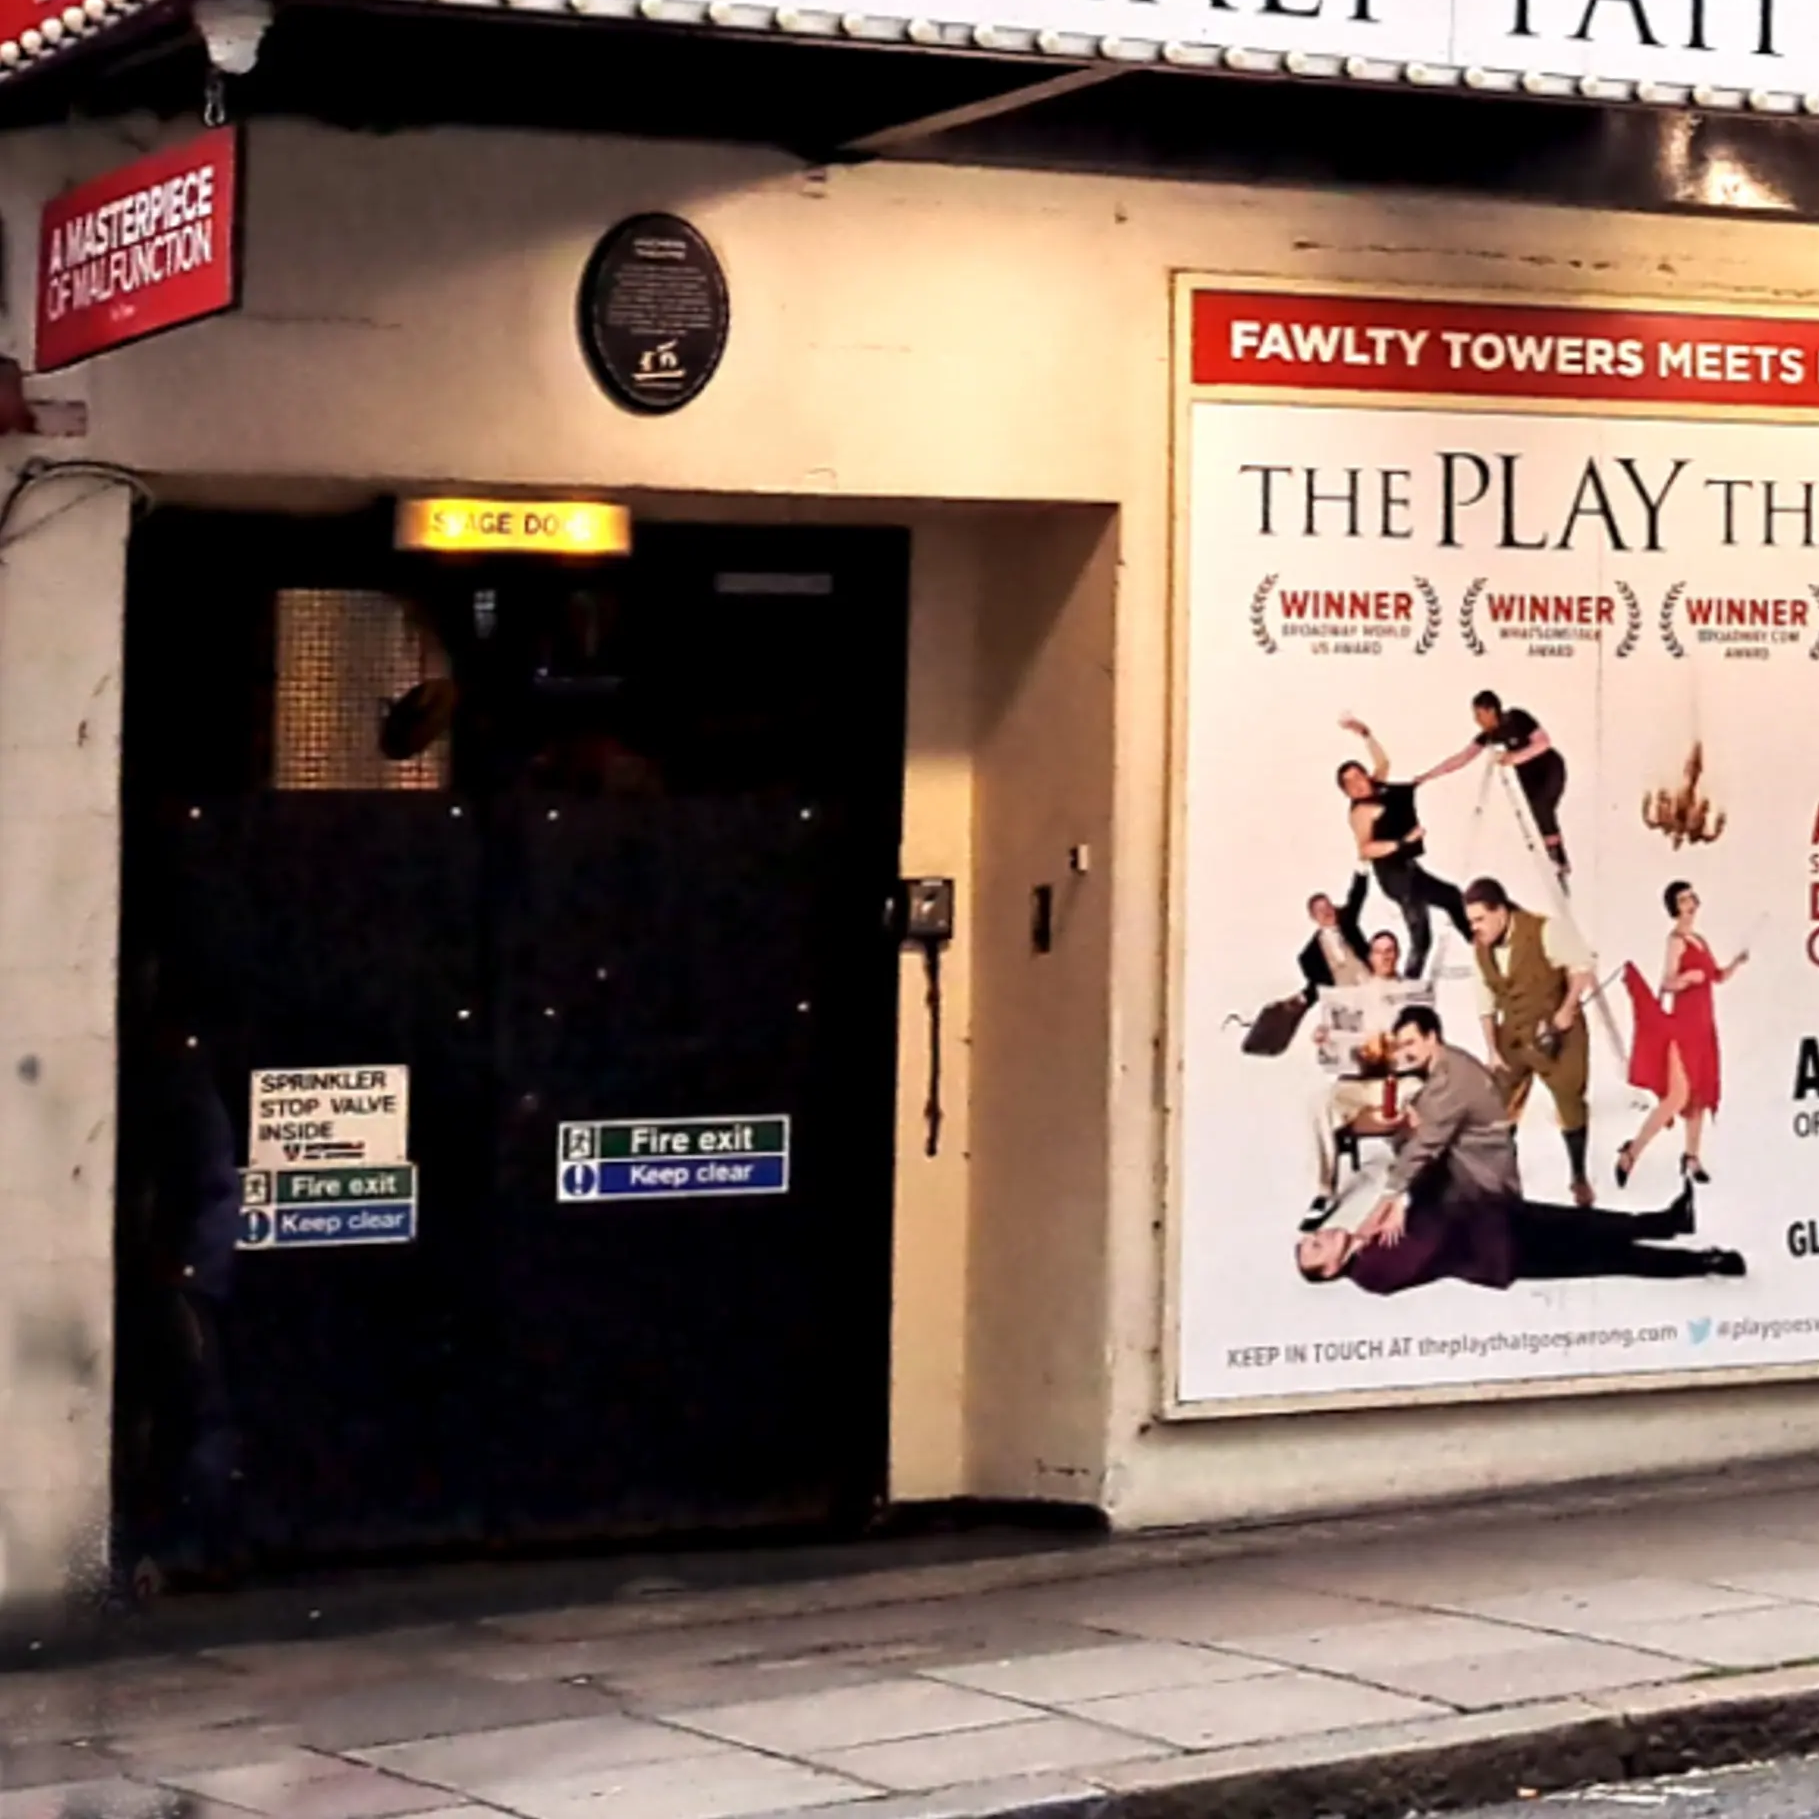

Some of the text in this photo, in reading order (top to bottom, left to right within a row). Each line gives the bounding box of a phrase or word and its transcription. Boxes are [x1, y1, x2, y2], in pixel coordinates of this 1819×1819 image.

[50, 166, 214, 273] A MASTERPIECE
[47, 221, 213, 321] OF MALFUNCTION
[1230, 321, 1428, 367] FAWLTY
[1442, 332, 1644, 377] TOWERS
[1657, 343, 1804, 384] MEETS
[1239, 465, 1413, 540] THE
[1435, 452, 1693, 552] PLAY
[1279, 590, 1413, 621] WINNER
[1487, 593, 1615, 624] WINNER
[1685, 598, 1809, 627] WINNER
[261, 1070, 386, 1093] SPRINKLER
[260, 1095, 397, 1118] STOP VALVE
[259, 1121, 334, 1141] INSIDE
[631, 1124, 753, 1154] Fire exit
[292, 1173, 398, 1198] Fire exit
[630, 1163, 754, 1187] Keep clear
[282, 1211, 406, 1235] Keep clear
[1227, 1346, 1280, 1368] KEEP
[1284, 1344, 1306, 1364] IN
[1313, 1339, 1383, 1364] TOUCH
[1388, 1337, 1413, 1357] AT
